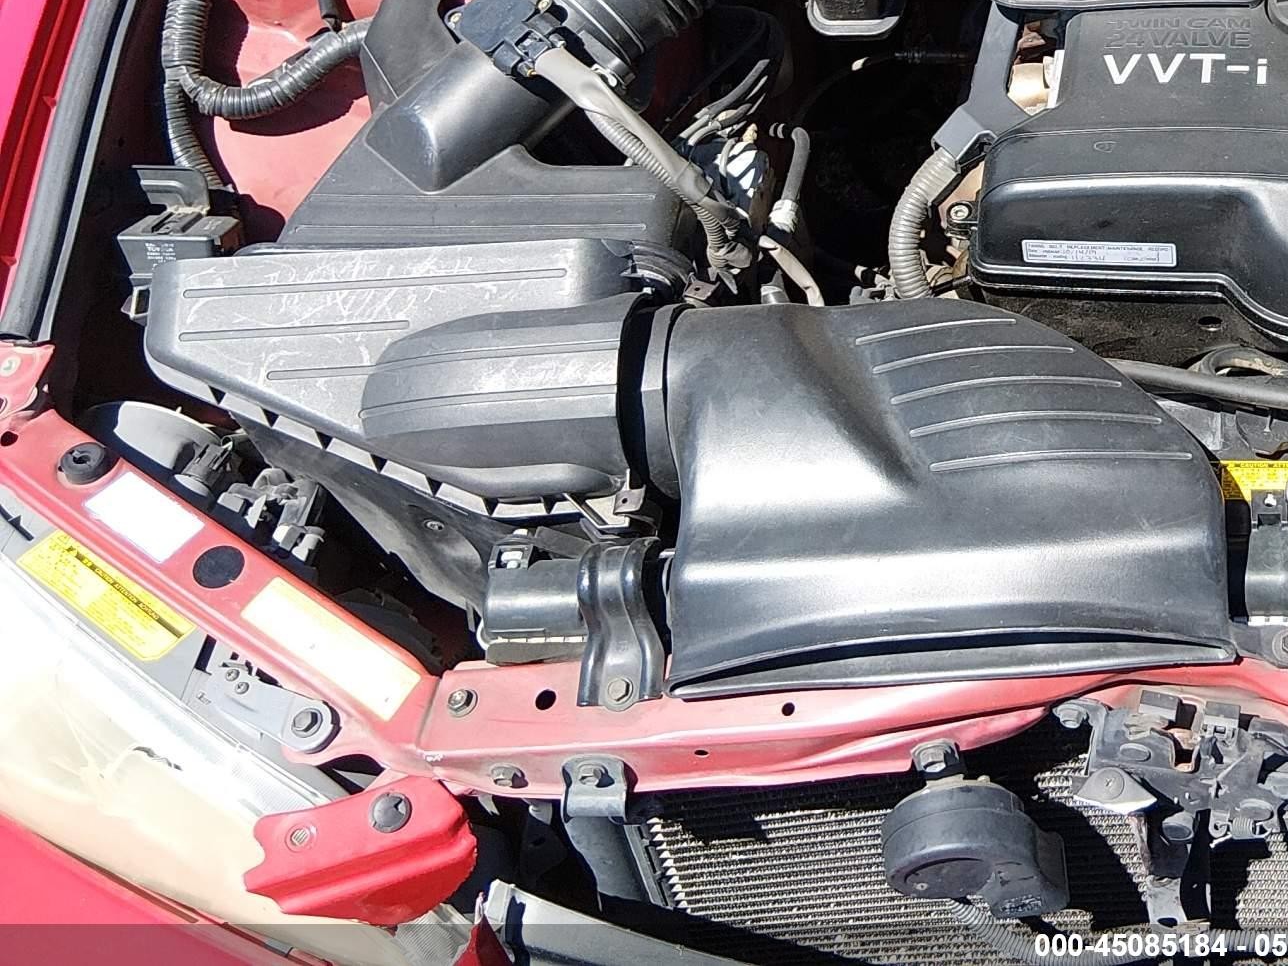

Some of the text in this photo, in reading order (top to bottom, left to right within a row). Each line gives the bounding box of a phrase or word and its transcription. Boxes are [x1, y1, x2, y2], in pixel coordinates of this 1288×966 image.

[1106, 17, 1251, 30] TWIN CAM
[1103, 52, 1268, 85] VVT-i
